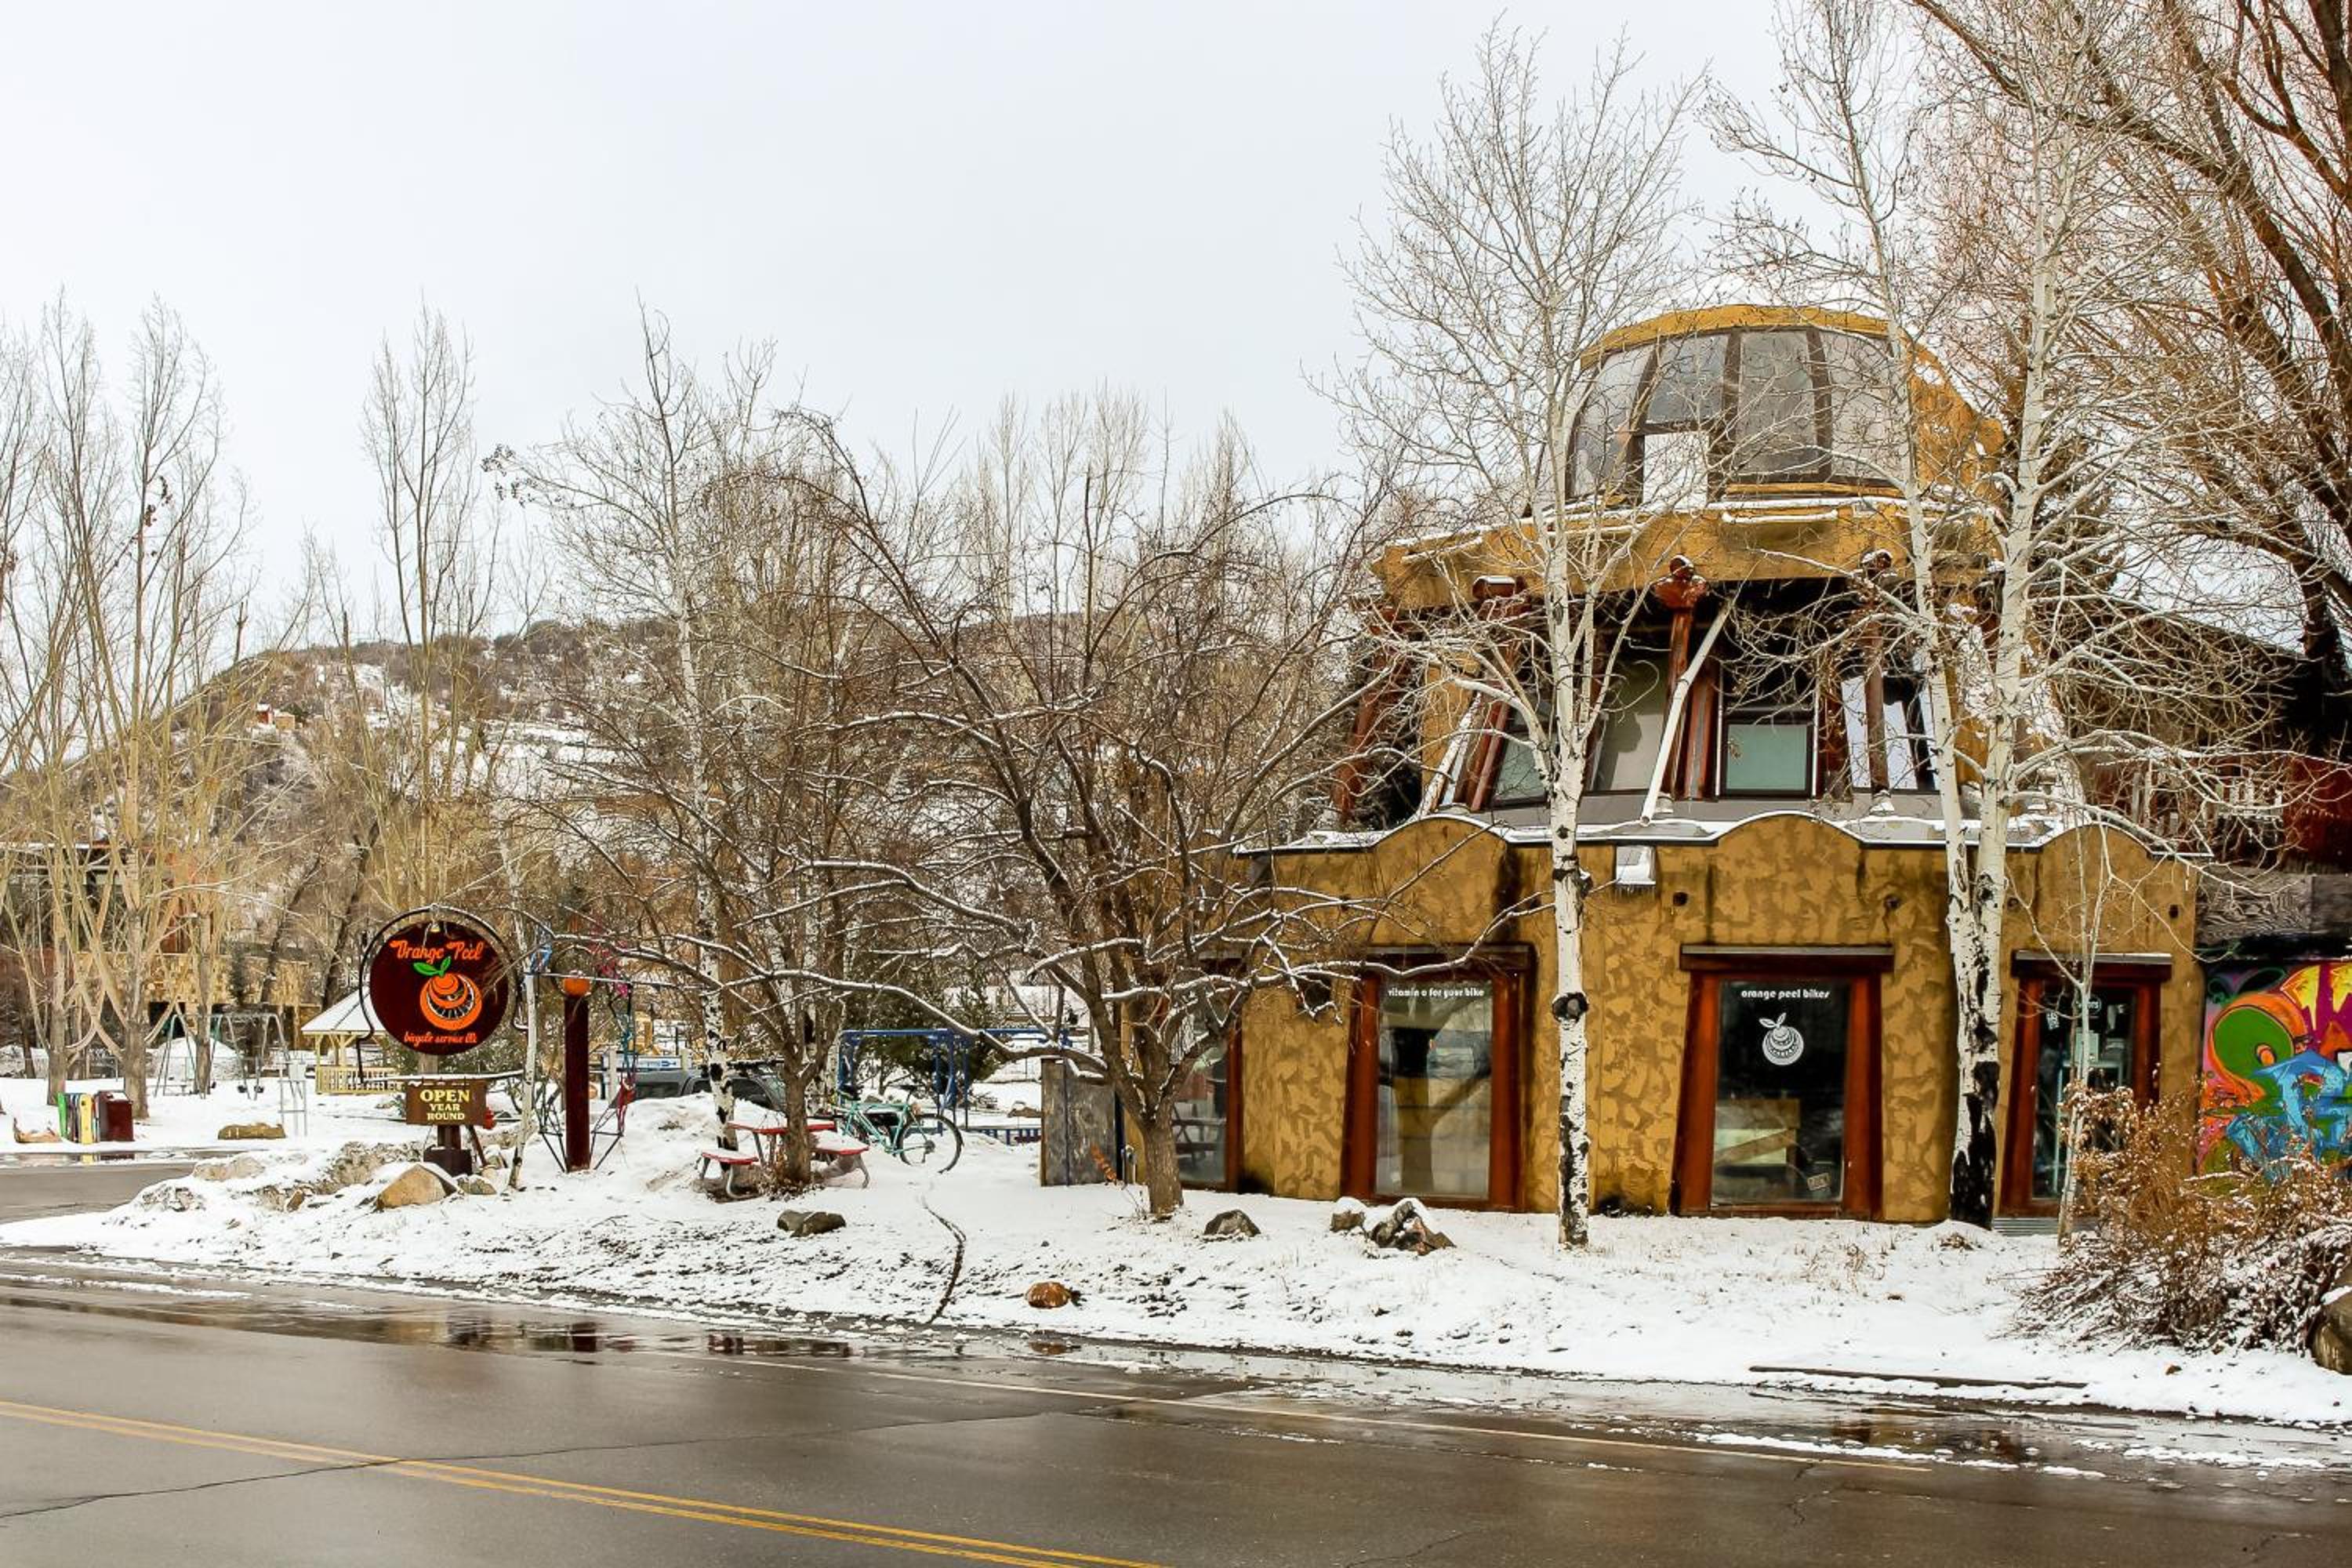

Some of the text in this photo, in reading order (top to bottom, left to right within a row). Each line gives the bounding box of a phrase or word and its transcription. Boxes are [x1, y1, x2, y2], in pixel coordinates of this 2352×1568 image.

[390, 940, 485, 964] Orange Peel
[1429, 987, 1442, 996] for
[1443, 989, 1463, 999] your
[1465, 987, 1485, 996] bike
[1741, 988, 1830, 1000] orange peel bikes
[419, 1089, 470, 1103] OPEN
